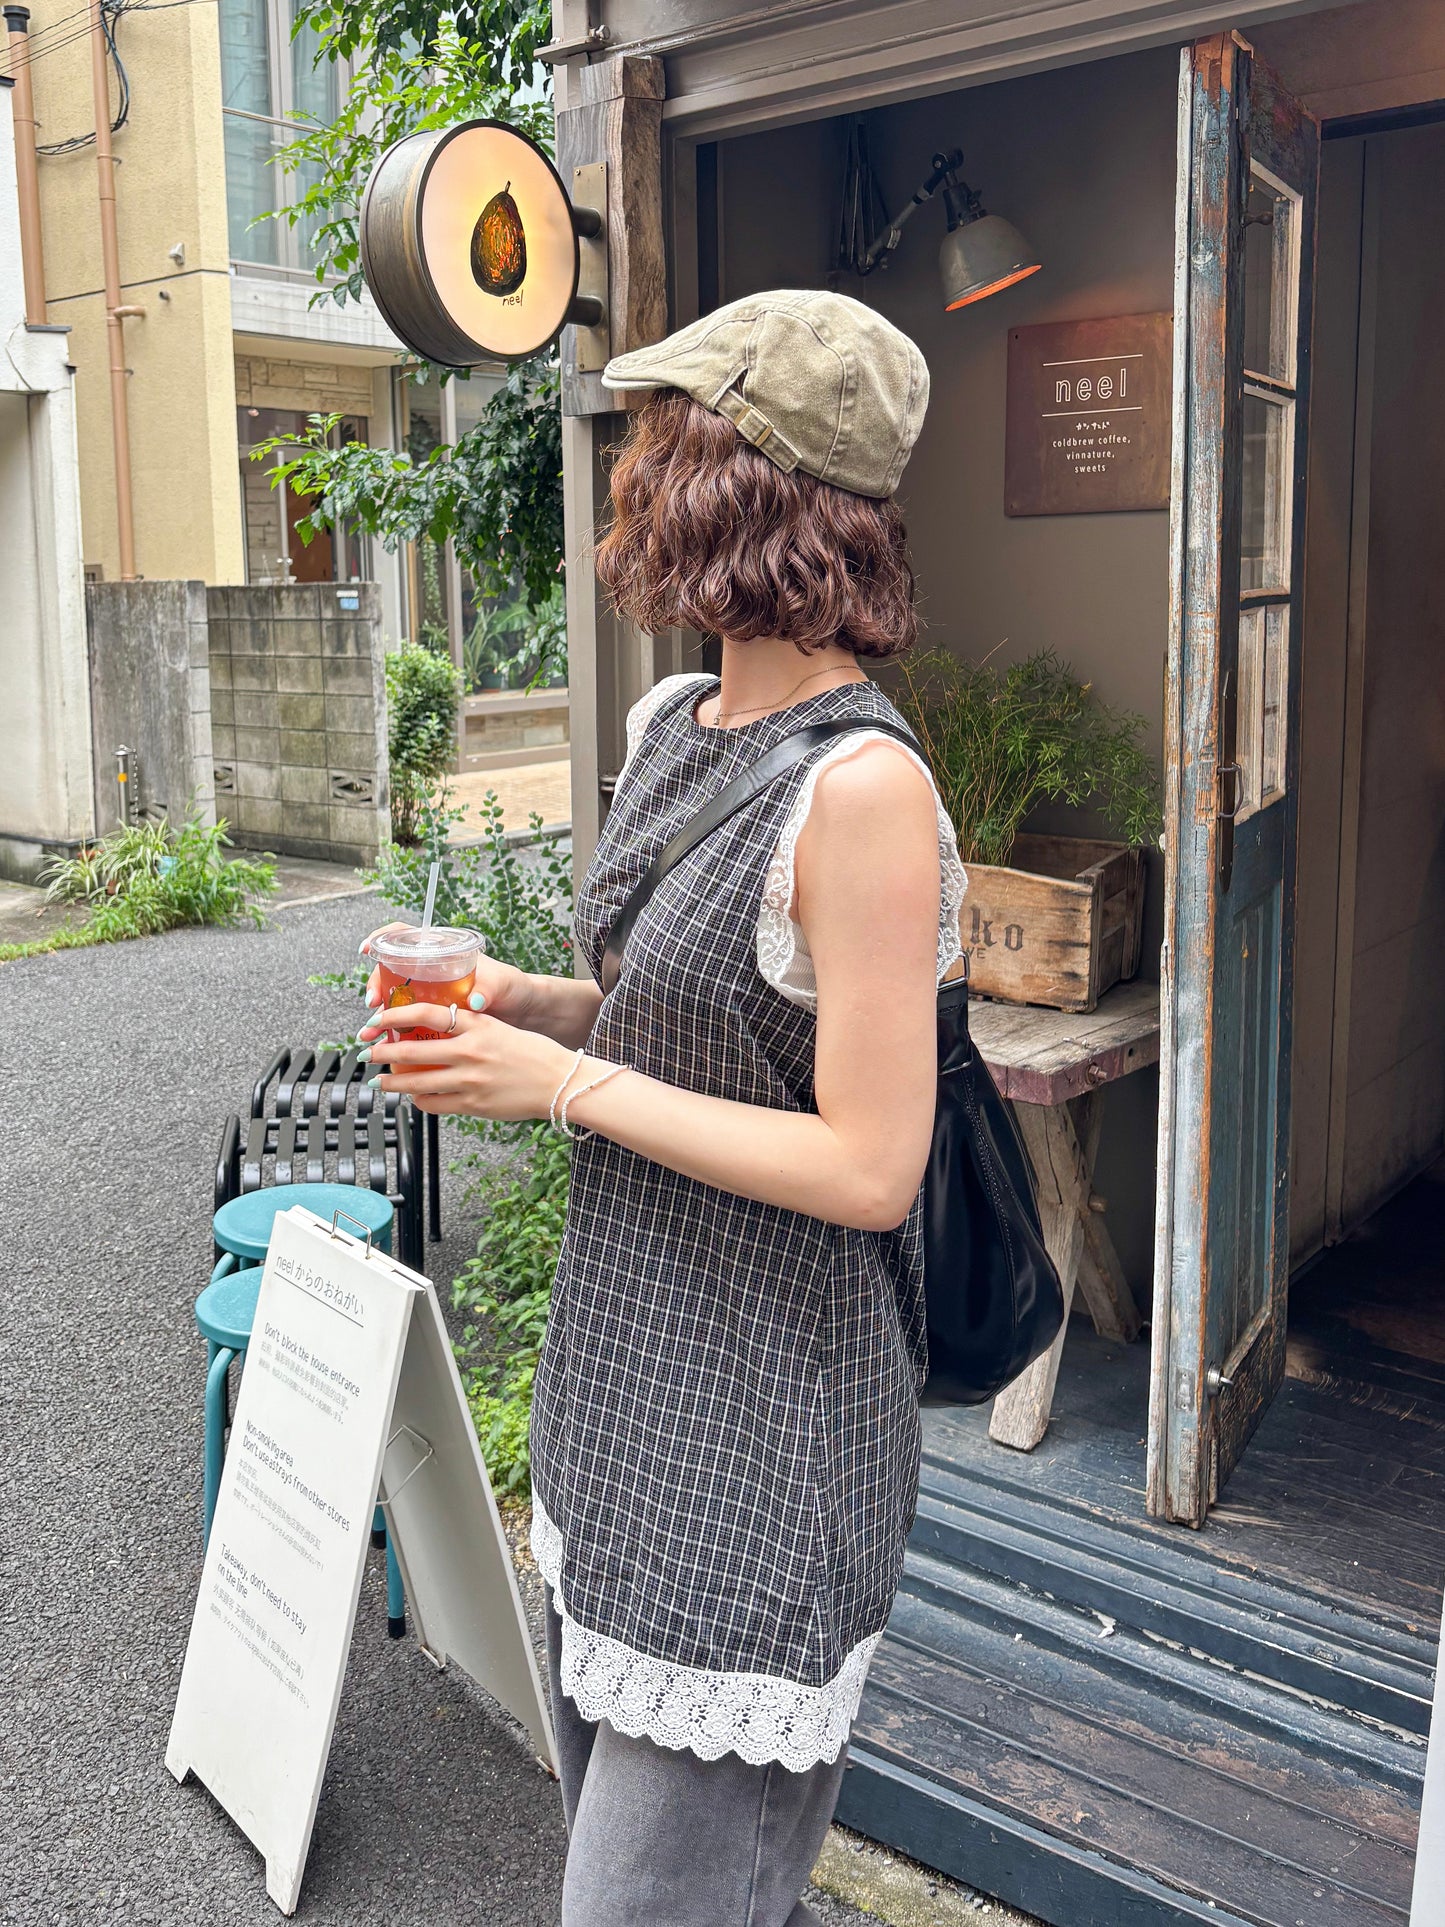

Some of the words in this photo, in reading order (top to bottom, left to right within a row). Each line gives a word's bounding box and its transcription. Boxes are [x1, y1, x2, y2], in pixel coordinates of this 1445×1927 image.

[502, 289, 524, 307] neel
[1056, 368, 1126, 403] neel
[1052, 438, 1094, 448] coldbrew
[1098, 434, 1131, 445] coffee,
[1066, 450, 1115, 461] vinnature,
[1074, 464, 1106, 474] sweets
[277, 1256, 294, 1275] neel
[295, 1264, 364, 1314] からのおねがい
[265, 1322, 280, 1342] Don't
[299, 1346, 309, 1362] the
[330, 1370, 360, 1397] entrance
[246, 1420, 280, 1459] Non-smoking
[280, 1450, 293, 1467] area
[243, 1435, 258, 1456] Don't
[259, 1451, 269, 1465] use
[293, 1476, 308, 1497] from
[308, 1491, 327, 1511] other
[327, 1506, 350, 1531] stores
[218, 1564, 225, 1576] on
[226, 1569, 236, 1587] the
[236, 1578, 248, 1598] line
[222, 1544, 248, 1581] Takeaway,
[250, 1573, 266, 1594] don't
[266, 1589, 282, 1609] need
[283, 1602, 290, 1617] to
[291, 1612, 306, 1635] stay
